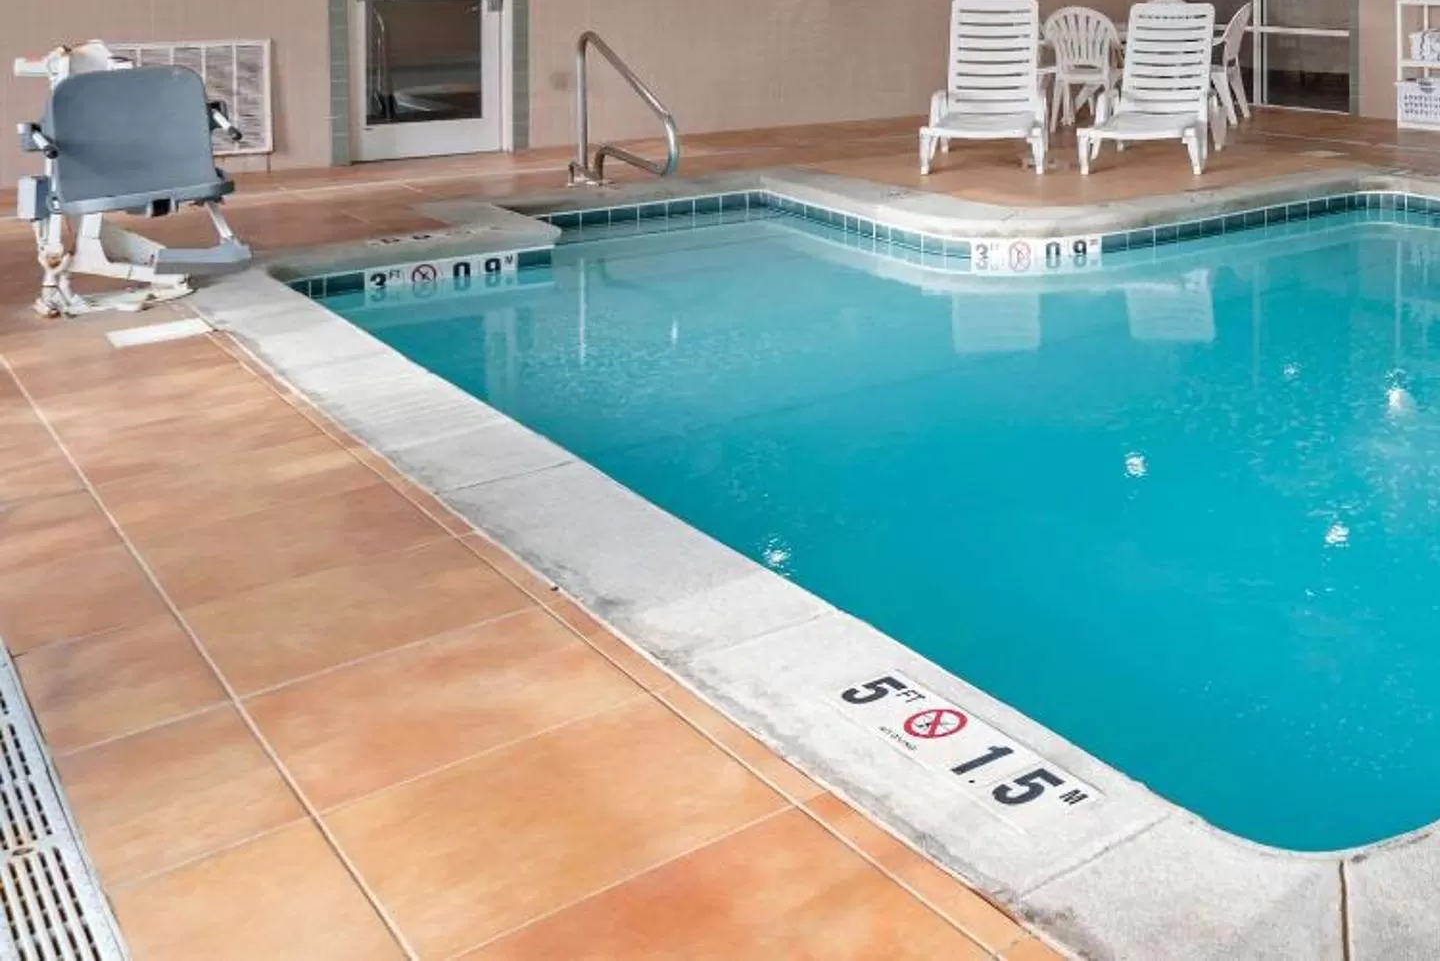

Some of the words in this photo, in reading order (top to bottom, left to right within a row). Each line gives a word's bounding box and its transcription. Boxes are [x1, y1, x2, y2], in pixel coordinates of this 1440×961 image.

[841, 676, 907, 705] 5
[896, 689, 926, 702] FT
[951, 745, 1066, 805] 1.5
